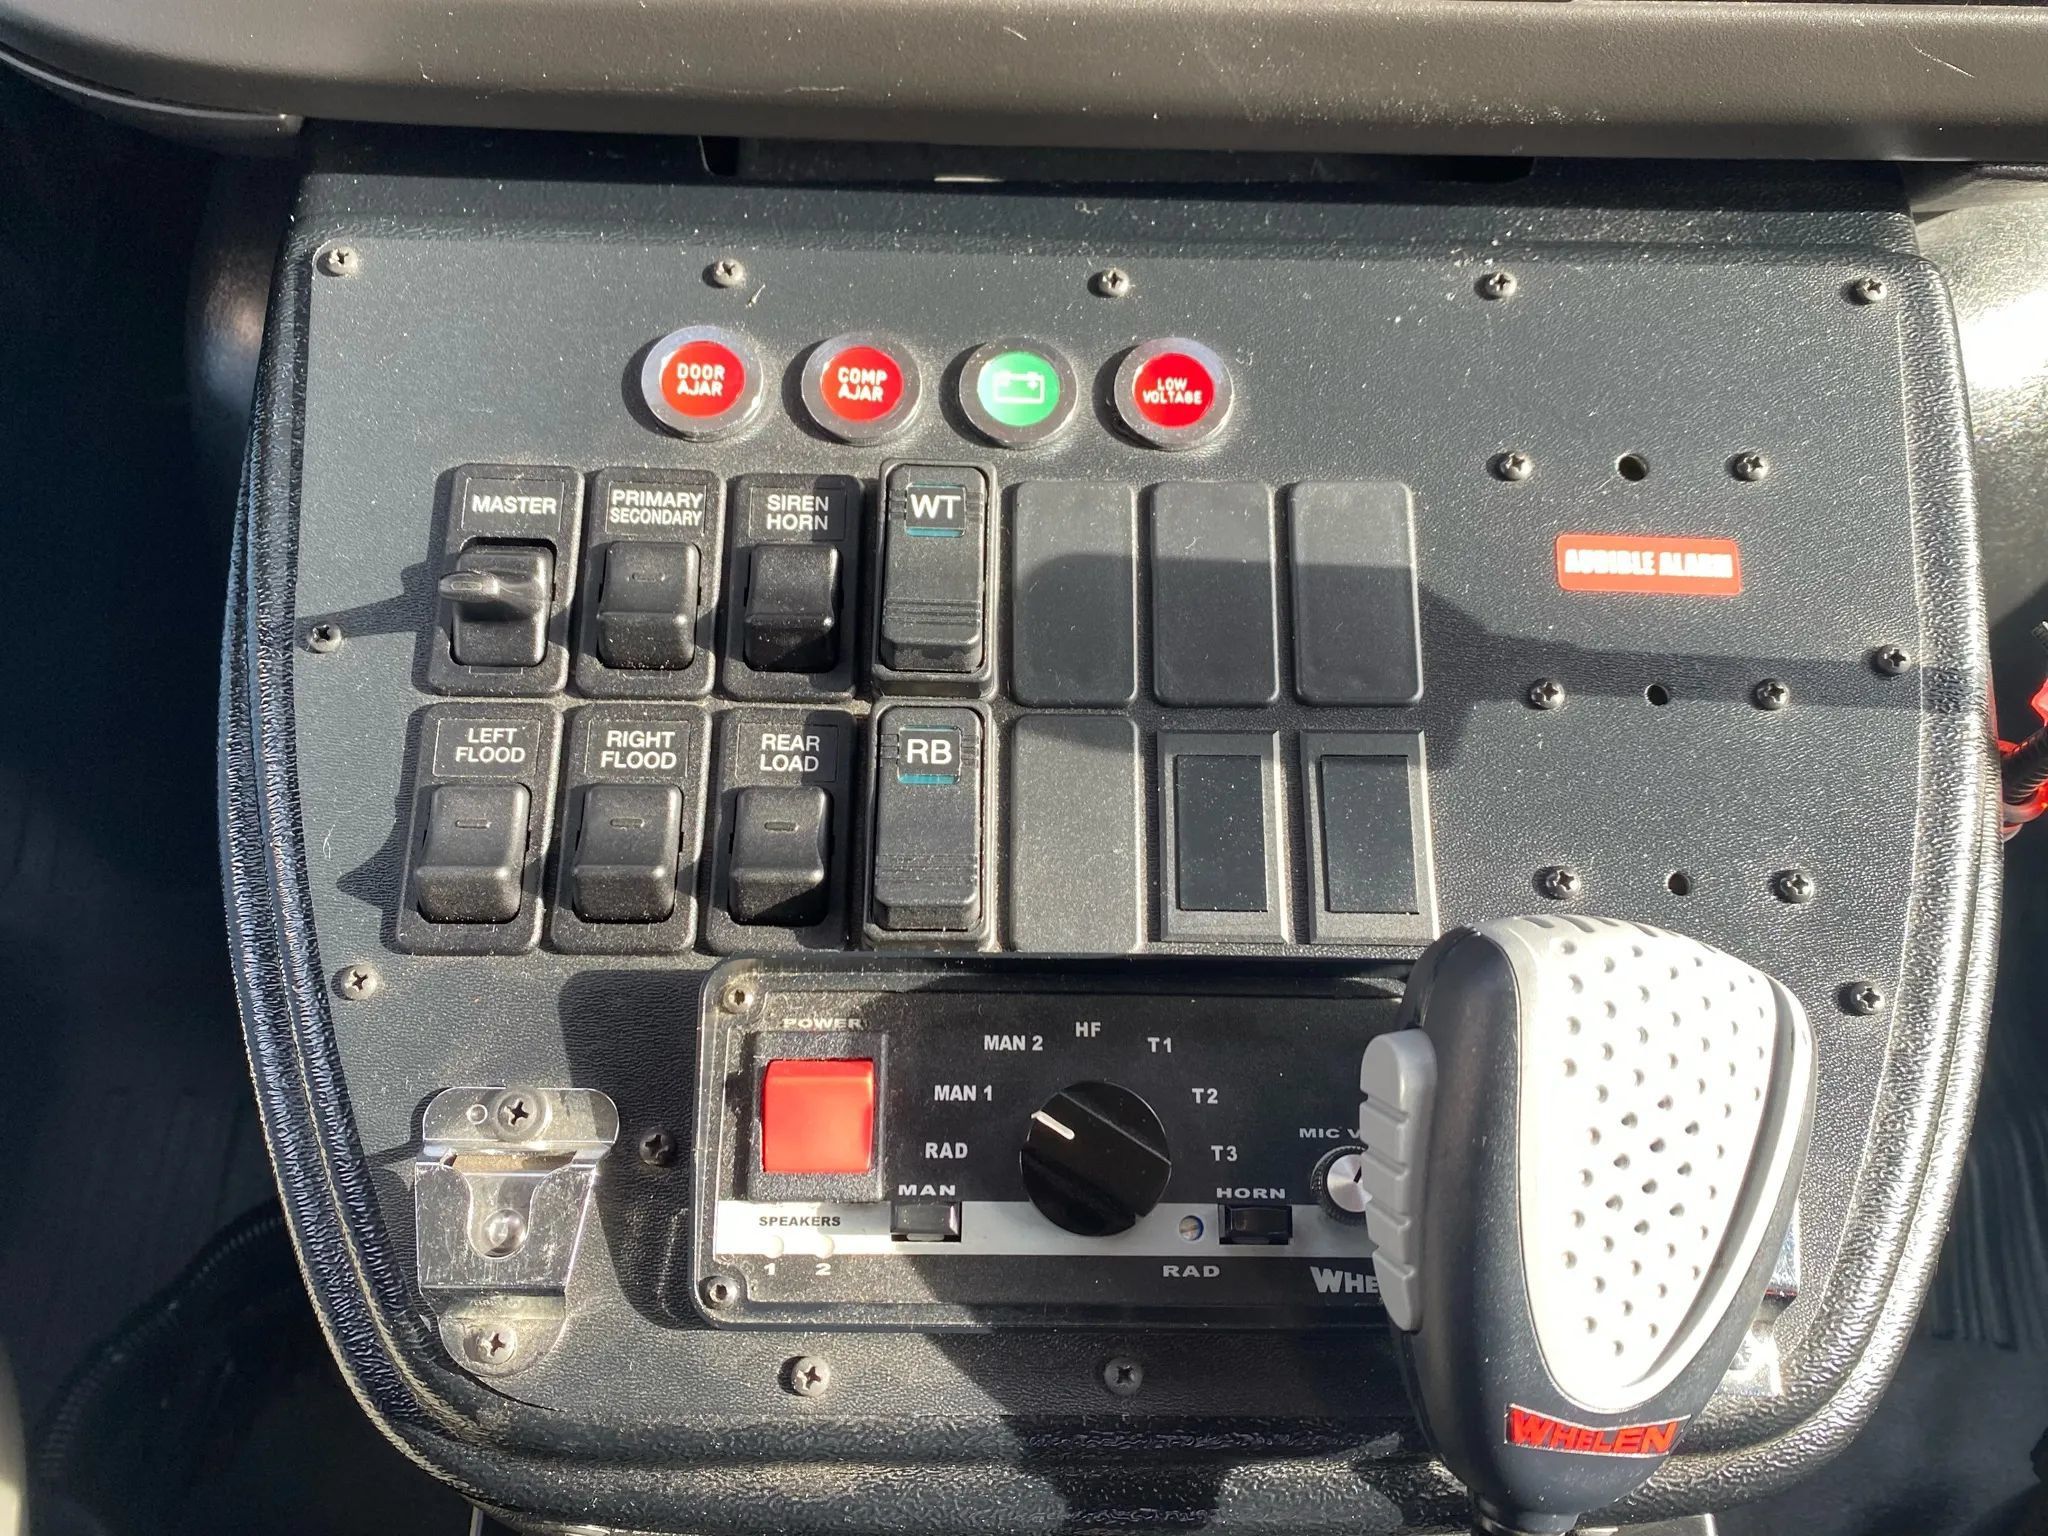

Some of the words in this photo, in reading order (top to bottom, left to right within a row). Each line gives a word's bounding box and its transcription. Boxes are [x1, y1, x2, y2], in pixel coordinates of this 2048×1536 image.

[677, 362, 726, 380] DOOR
[837, 367, 888, 384] COMP
[677, 380, 723, 397] AJAR
[838, 384, 884, 402] AJAR
[1156, 378, 1188, 391] LOW
[1142, 390, 1203, 405] VOLTAGE
[471, 496, 557, 515] MASTER
[611, 489, 704, 508] PRIMARY
[766, 495, 830, 511] SIREN
[909, 495, 961, 518] WT
[609, 507, 703, 526] SECONDARY
[766, 514, 829, 531] HORN
[467, 727, 515, 744] LEFT
[606, 731, 676, 750] RIGHT
[761, 733, 820, 752] REAR
[455, 745, 526, 764] FLOOD
[600, 750, 677, 769] FLOOD
[906, 739, 953, 764] RB
[759, 753, 819, 772] LOAD
[783, 1017, 863, 1030] POWER
[1075, 1021, 1101, 1038] HF
[983, 1034, 1027, 1051] MAN
[1031, 1034, 1044, 1051] 2
[934, 1085, 977, 1101] MAN
[984, 1085, 994, 1101] 1
[1192, 1088, 1219, 1104] T2
[1299, 1127, 1340, 1139] MIC
[925, 1142, 969, 1159] RAD
[1211, 1145, 1238, 1162] T3
[898, 1184, 956, 1197] MAN
[1216, 1187, 1286, 1199] HORN
[758, 1215, 842, 1227] SPEAKERS
[763, 1264, 775, 1275] 1
[815, 1264, 832, 1276] 2
[1162, 1265, 1221, 1277] RAD
[1511, 1409, 1678, 1454] WHELEN
